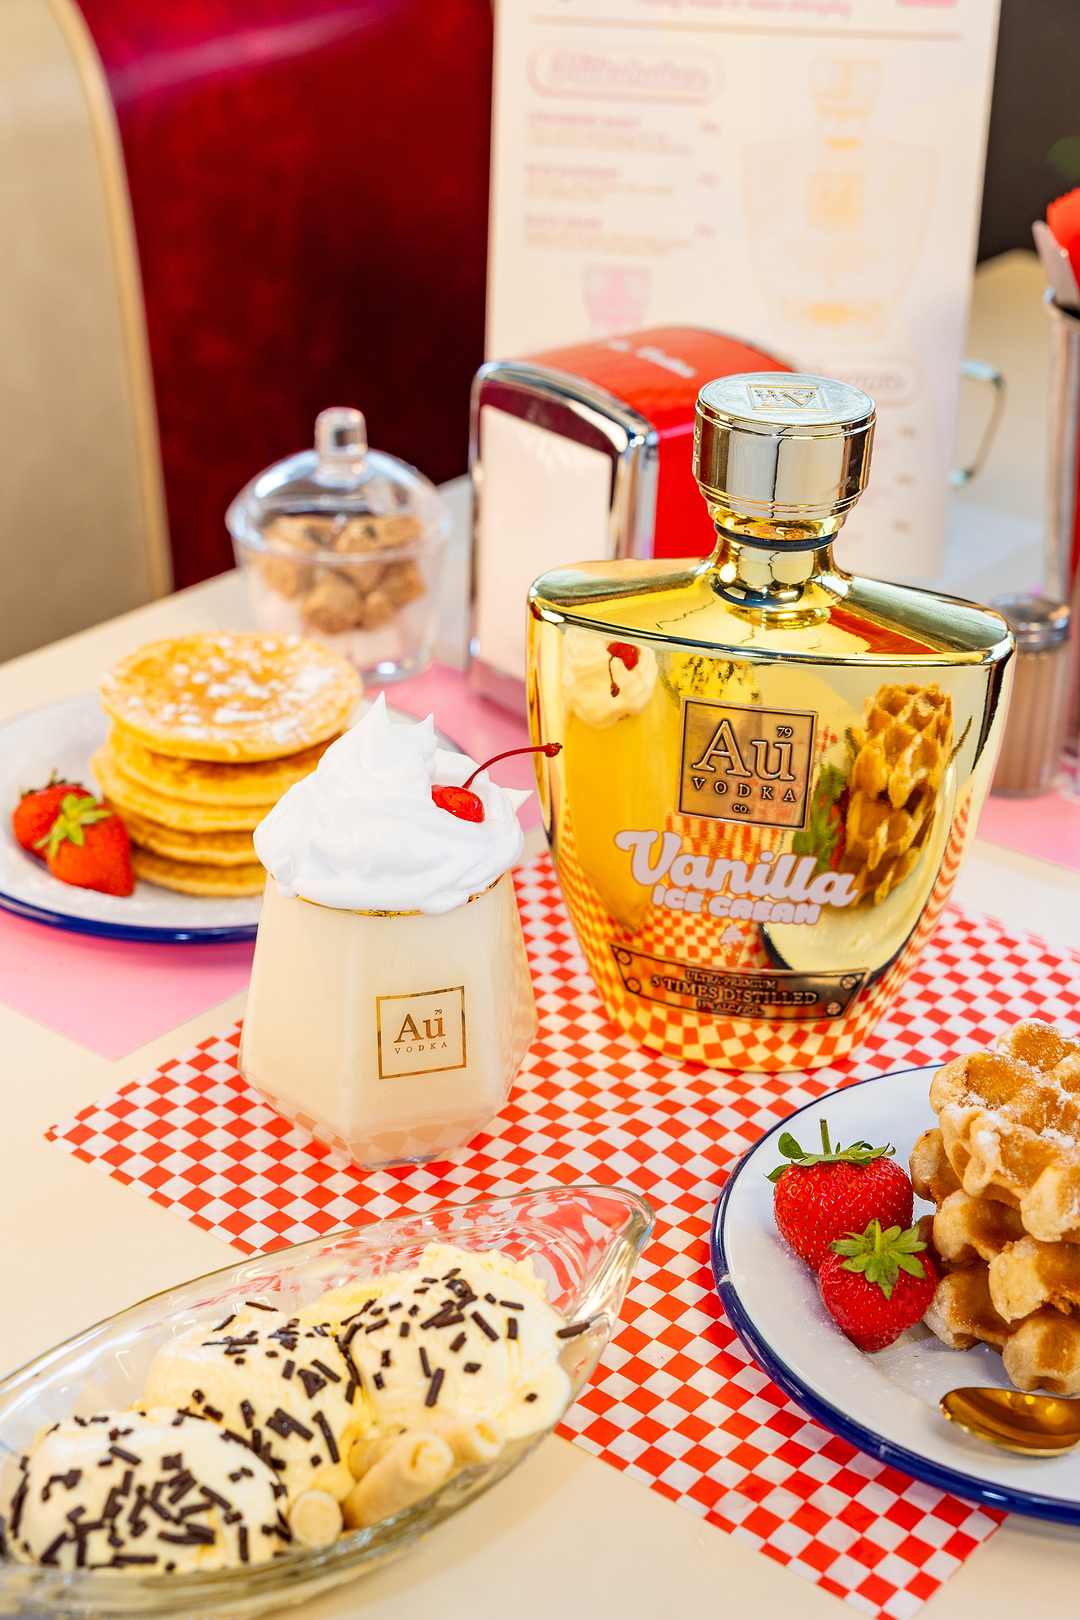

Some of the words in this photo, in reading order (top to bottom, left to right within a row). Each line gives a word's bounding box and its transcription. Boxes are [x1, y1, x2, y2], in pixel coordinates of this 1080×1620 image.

[692, 720, 796, 781] Au
[776, 726, 793, 738] 79
[692, 777, 796, 802] VODKA
[732, 804, 751, 814] CO.
[614, 829, 859, 907] Vanilla
[652, 885, 705, 913] ICE
[708, 896, 821, 925] CREAM
[664, 977, 718, 1000] TIMES
[722, 987, 818, 1005] DISTILLED
[393, 1013, 446, 1043] Au
[434, 1008, 443, 1016] 79
[394, 1041, 448, 1054] VODKA
